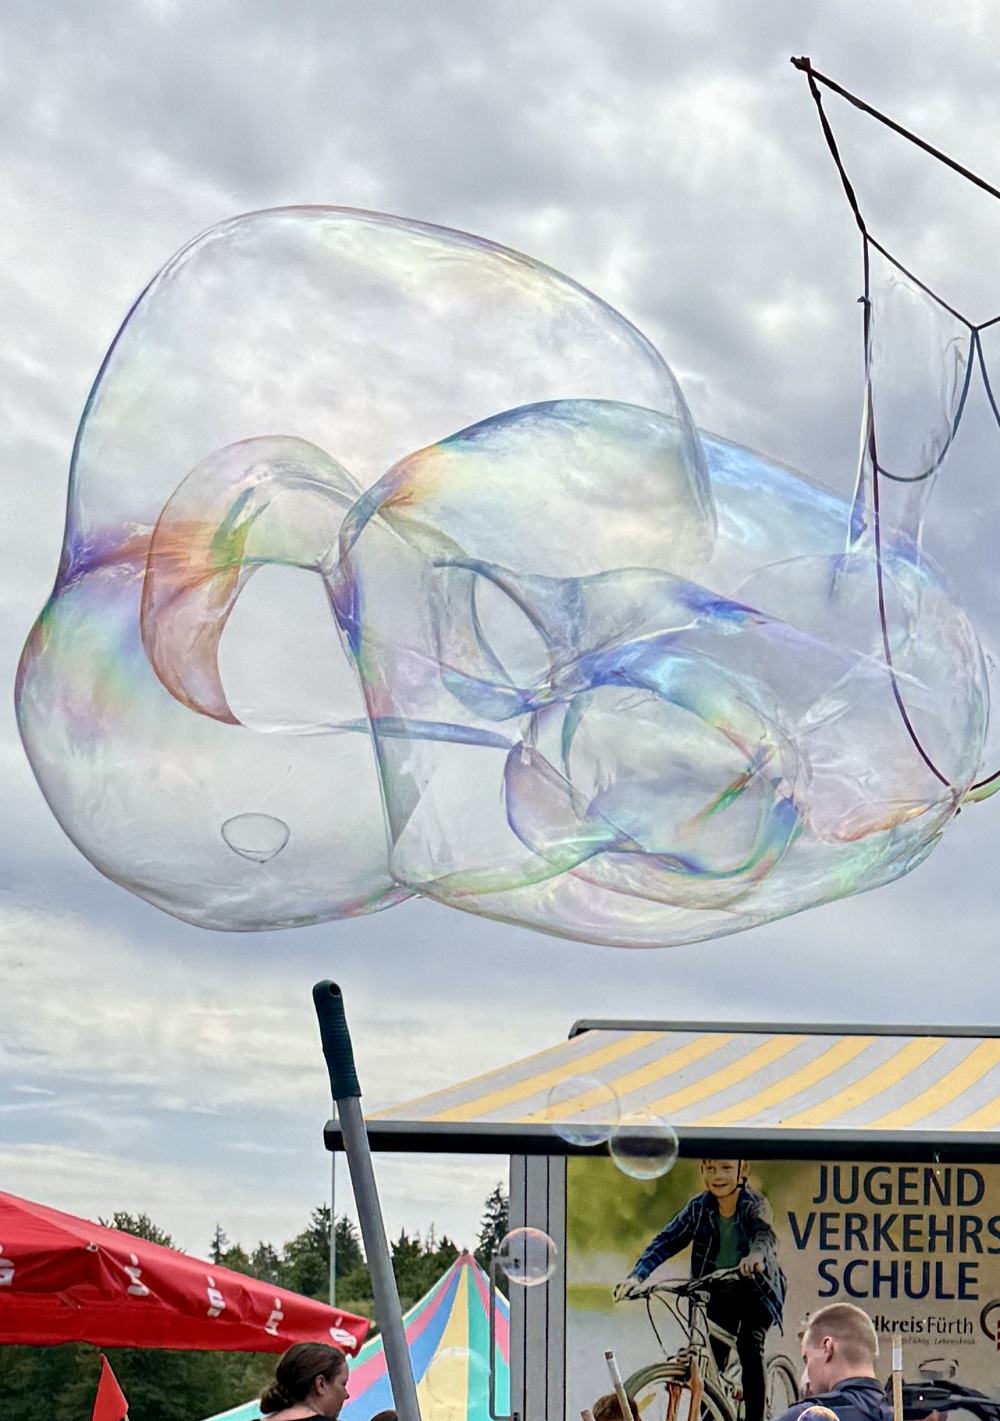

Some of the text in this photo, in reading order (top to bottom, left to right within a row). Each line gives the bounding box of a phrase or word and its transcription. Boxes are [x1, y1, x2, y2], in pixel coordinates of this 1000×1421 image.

[812, 1165, 986, 1206] JUGEND
[817, 1258, 980, 1301] SCHULE
[927, 1316, 973, 1334] Fürth
